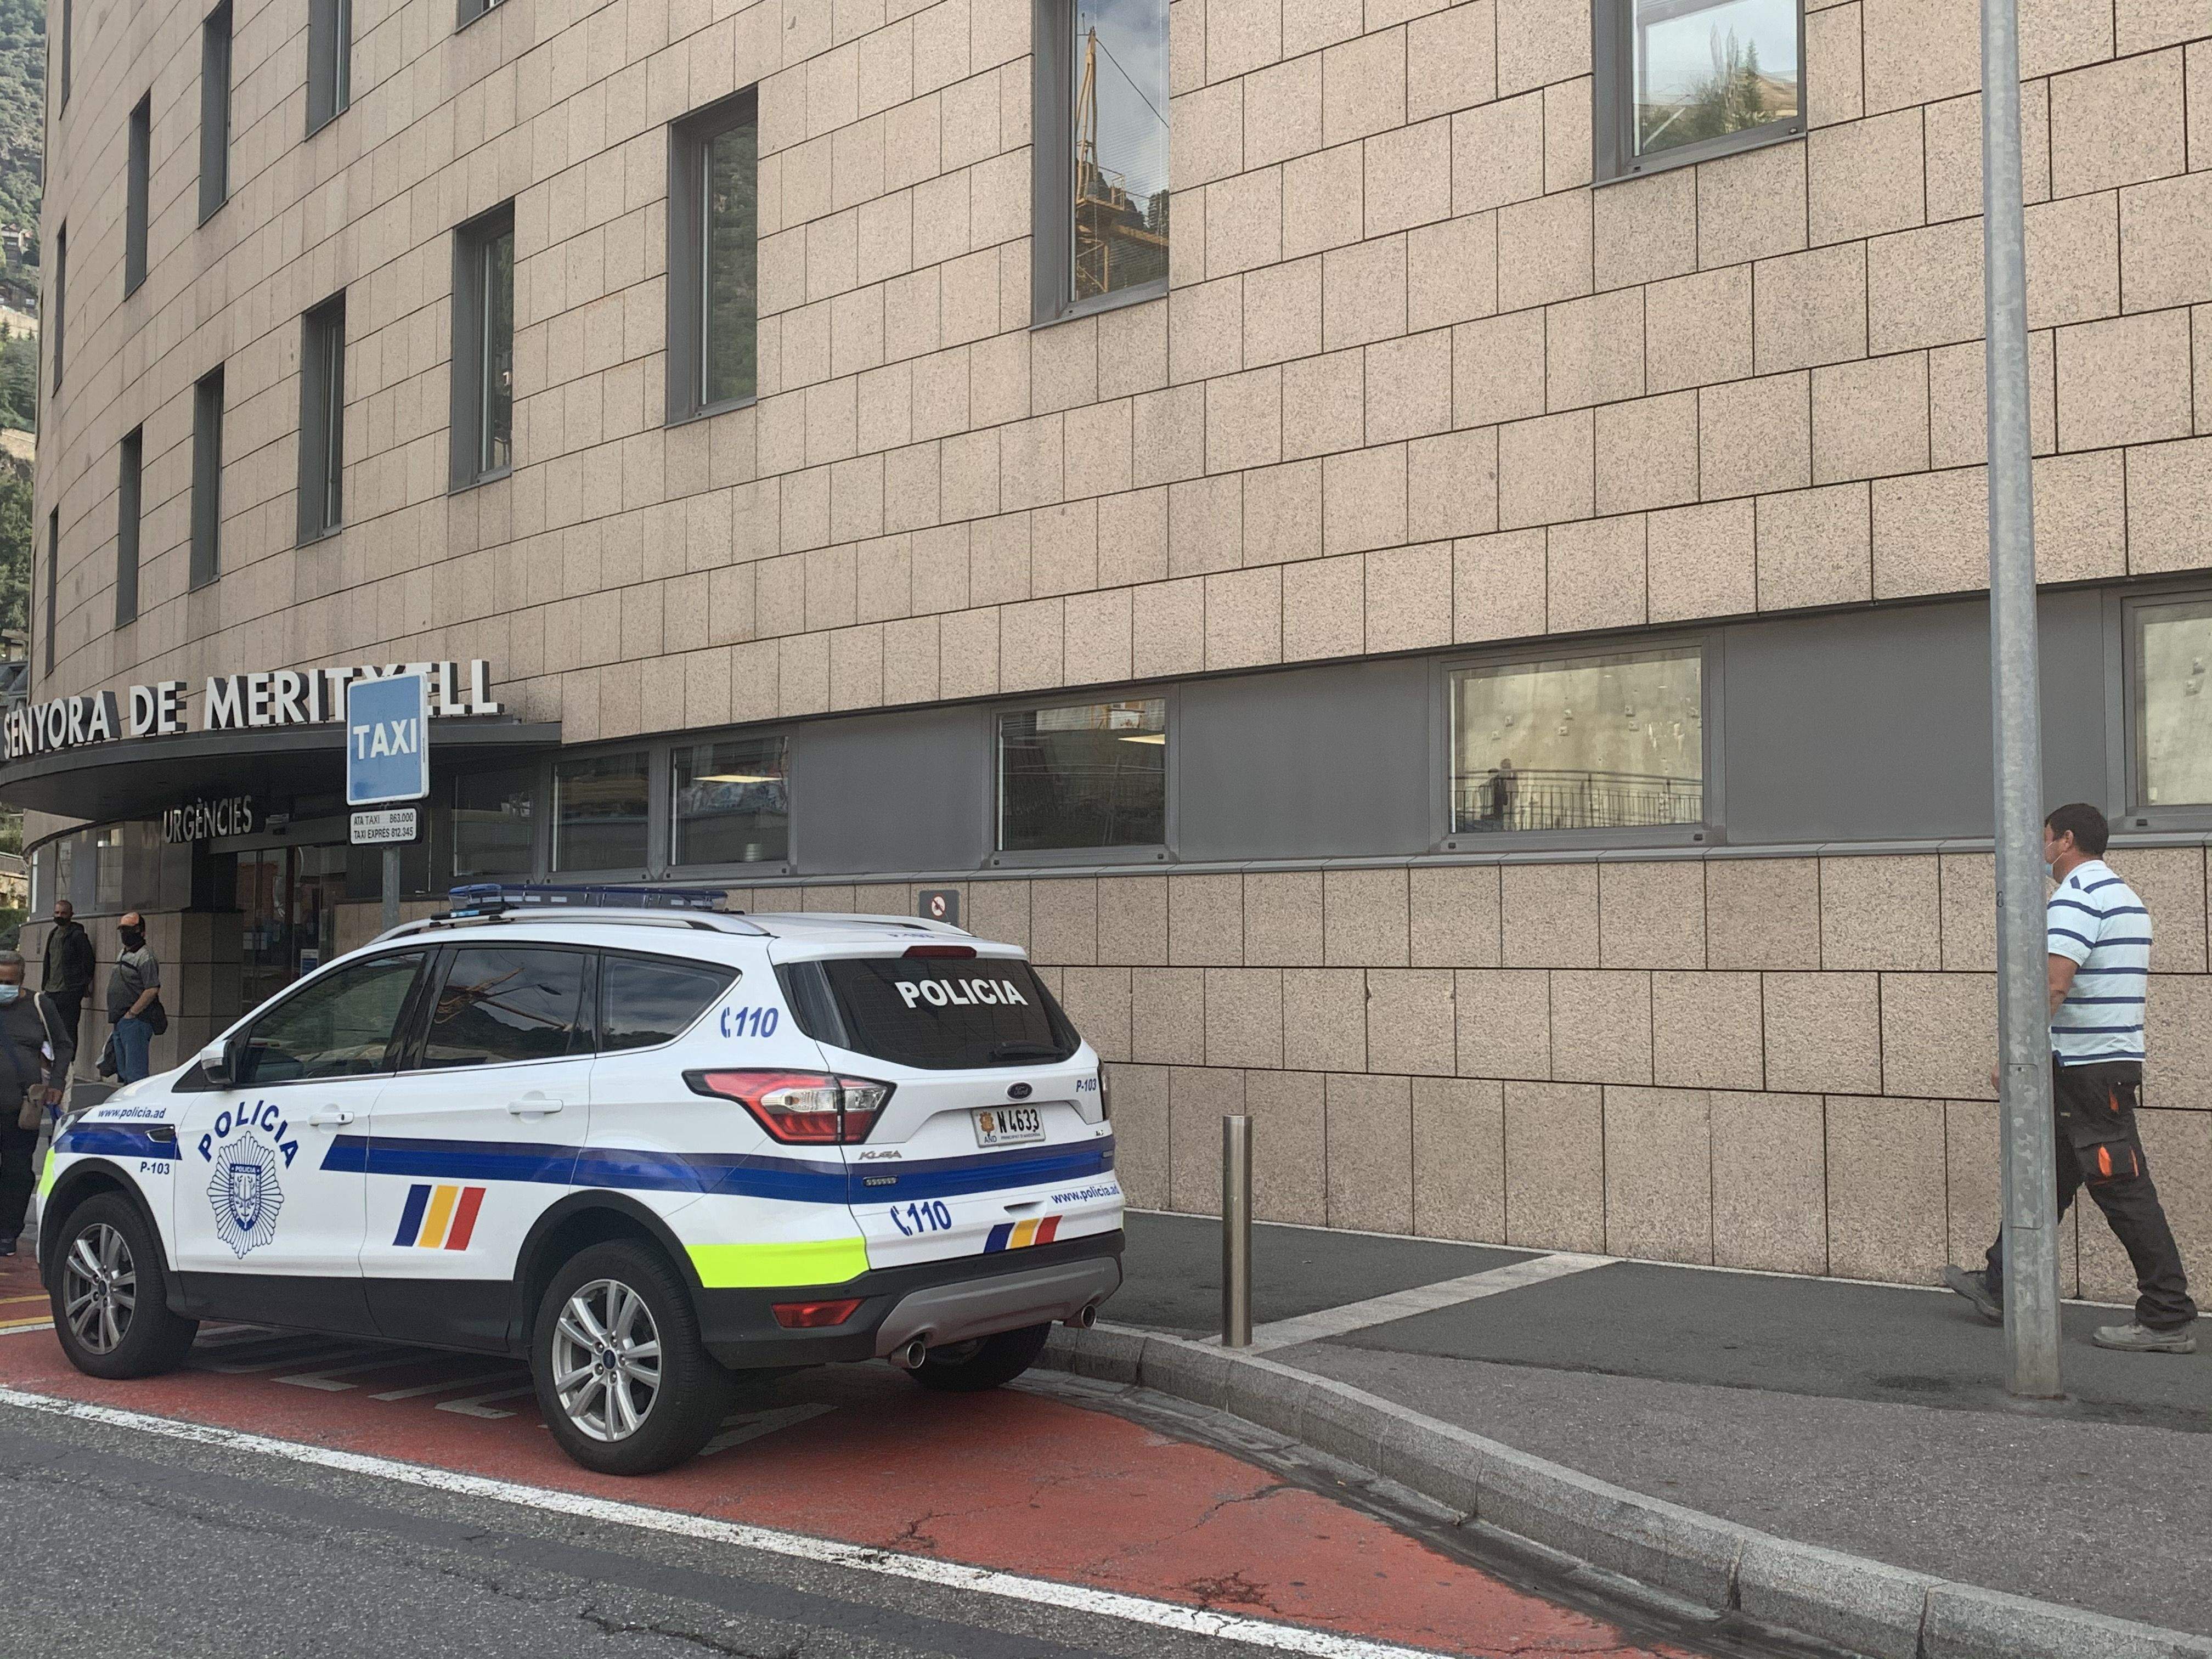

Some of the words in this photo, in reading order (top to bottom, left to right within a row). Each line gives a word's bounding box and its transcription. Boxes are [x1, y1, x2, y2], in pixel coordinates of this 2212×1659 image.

[4, 690, 111, 760] SENYORA
[129, 680, 177, 736] DE
[203, 659, 498, 730] MERITLL
[353, 718, 417, 760] TAXI
[163, 795, 252, 843] URGÈNCIES
[354, 816, 364, 826] ATA
[365, 815, 380, 825] TAXI
[354, 829, 366, 839] TAXI
[391, 827, 414, 838] 812.345
[895, 979, 1029, 1008] POLICIA
[735, 1006, 779, 1038] 110
[1076, 1078, 1097, 1093] P-103
[98, 1107, 167, 1120] www.policia.ad
[198, 1099, 299, 1170] POLICIA
[984, 1135, 997, 1144] AND
[140, 1161, 170, 1175] P-103
[907, 1200, 952, 1233] 110
